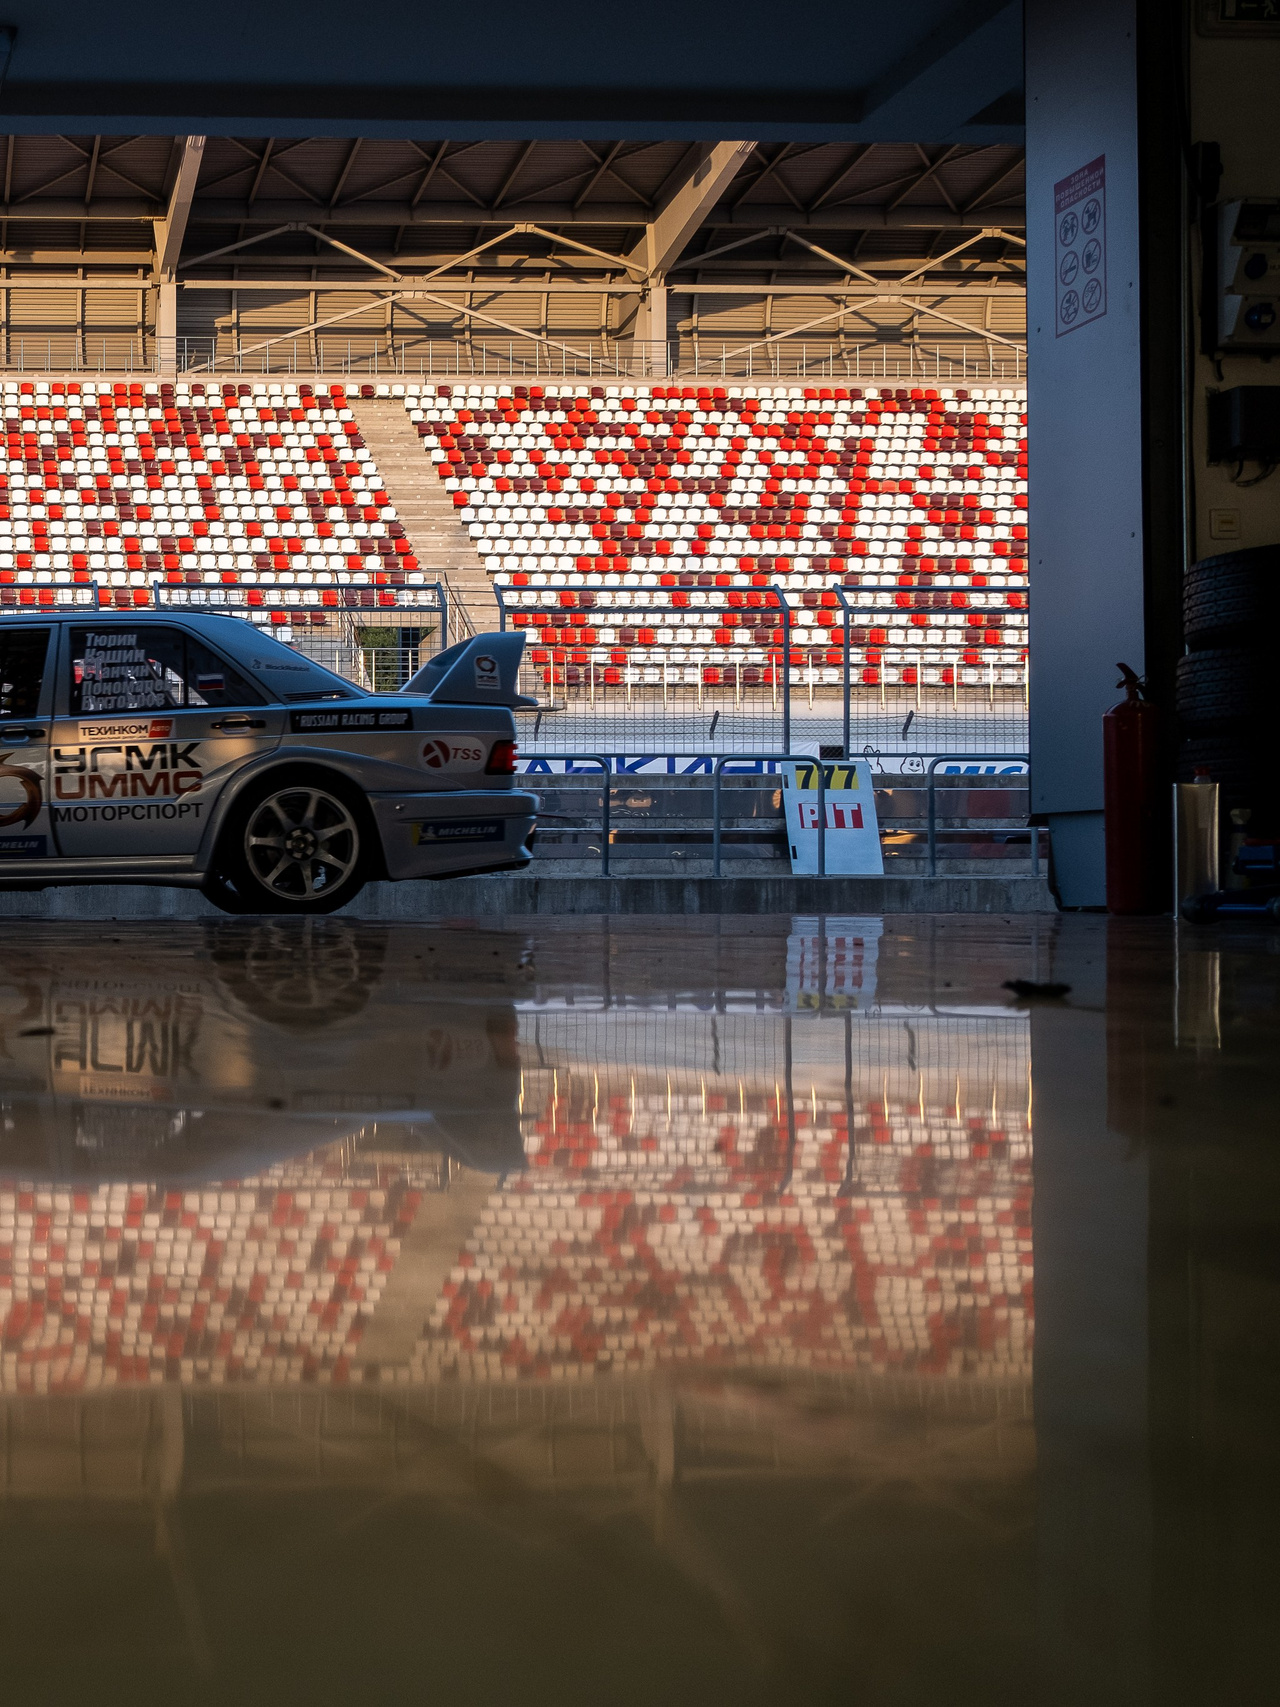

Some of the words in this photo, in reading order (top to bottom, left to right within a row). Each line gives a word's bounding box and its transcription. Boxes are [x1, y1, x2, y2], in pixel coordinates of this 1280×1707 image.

[1056, 167, 1104, 203] ПОВЫШЕННОЙ
[1070, 169, 1089, 185] ЗОНА
[1060, 178, 1101, 208] ОПАСНОСТИ
[300, 714, 339, 727] RUSSIAN
[341, 713, 375, 726] RACING
[378, 713, 408, 725] GROUP
[80, 725, 148, 737] ТЕХИНКОМ
[55, 743, 202, 773] УГМК
[452, 747, 482, 761] TSS
[55, 771, 202, 799] UMMC
[54, 803, 204, 822] МОТОРСПОРТ
[801, 803, 859, 828] PIT
[438, 826, 497, 836] MICHELIN
